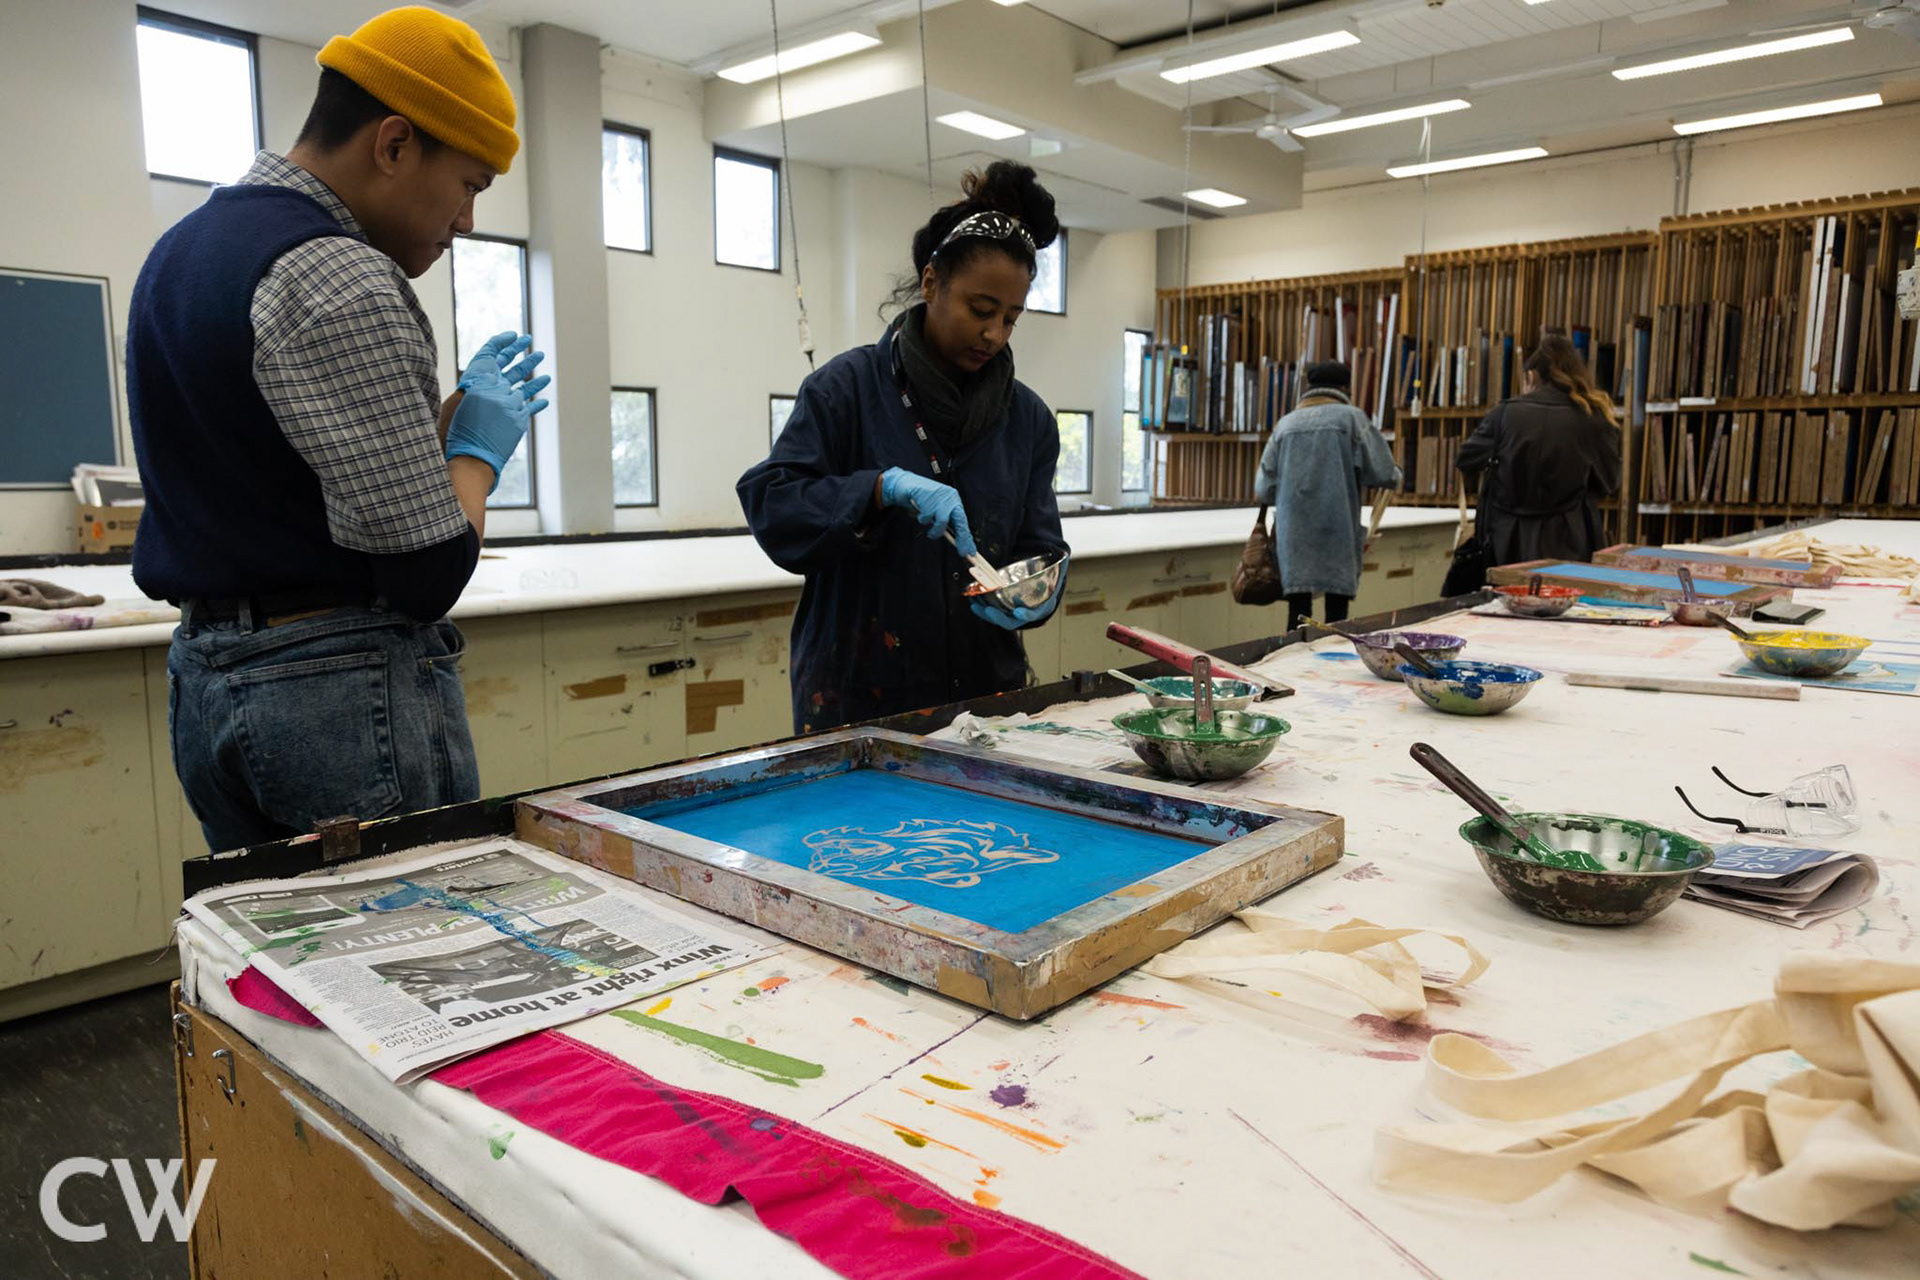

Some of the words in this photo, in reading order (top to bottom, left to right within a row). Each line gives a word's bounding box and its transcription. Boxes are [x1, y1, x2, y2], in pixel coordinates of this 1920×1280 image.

[331, 922, 444, 951] PLENTY!
[654, 944, 733, 972] Winx
[582, 968, 657, 997] right
[545, 991, 582, 1006] at
[421, 1017, 440, 1028] TO
[448, 1000, 551, 1028] home
[378, 1024, 419, 1045] ATONE
[385, 1031, 415, 1049] TRIO
[417, 1023, 448, 1038] REID
